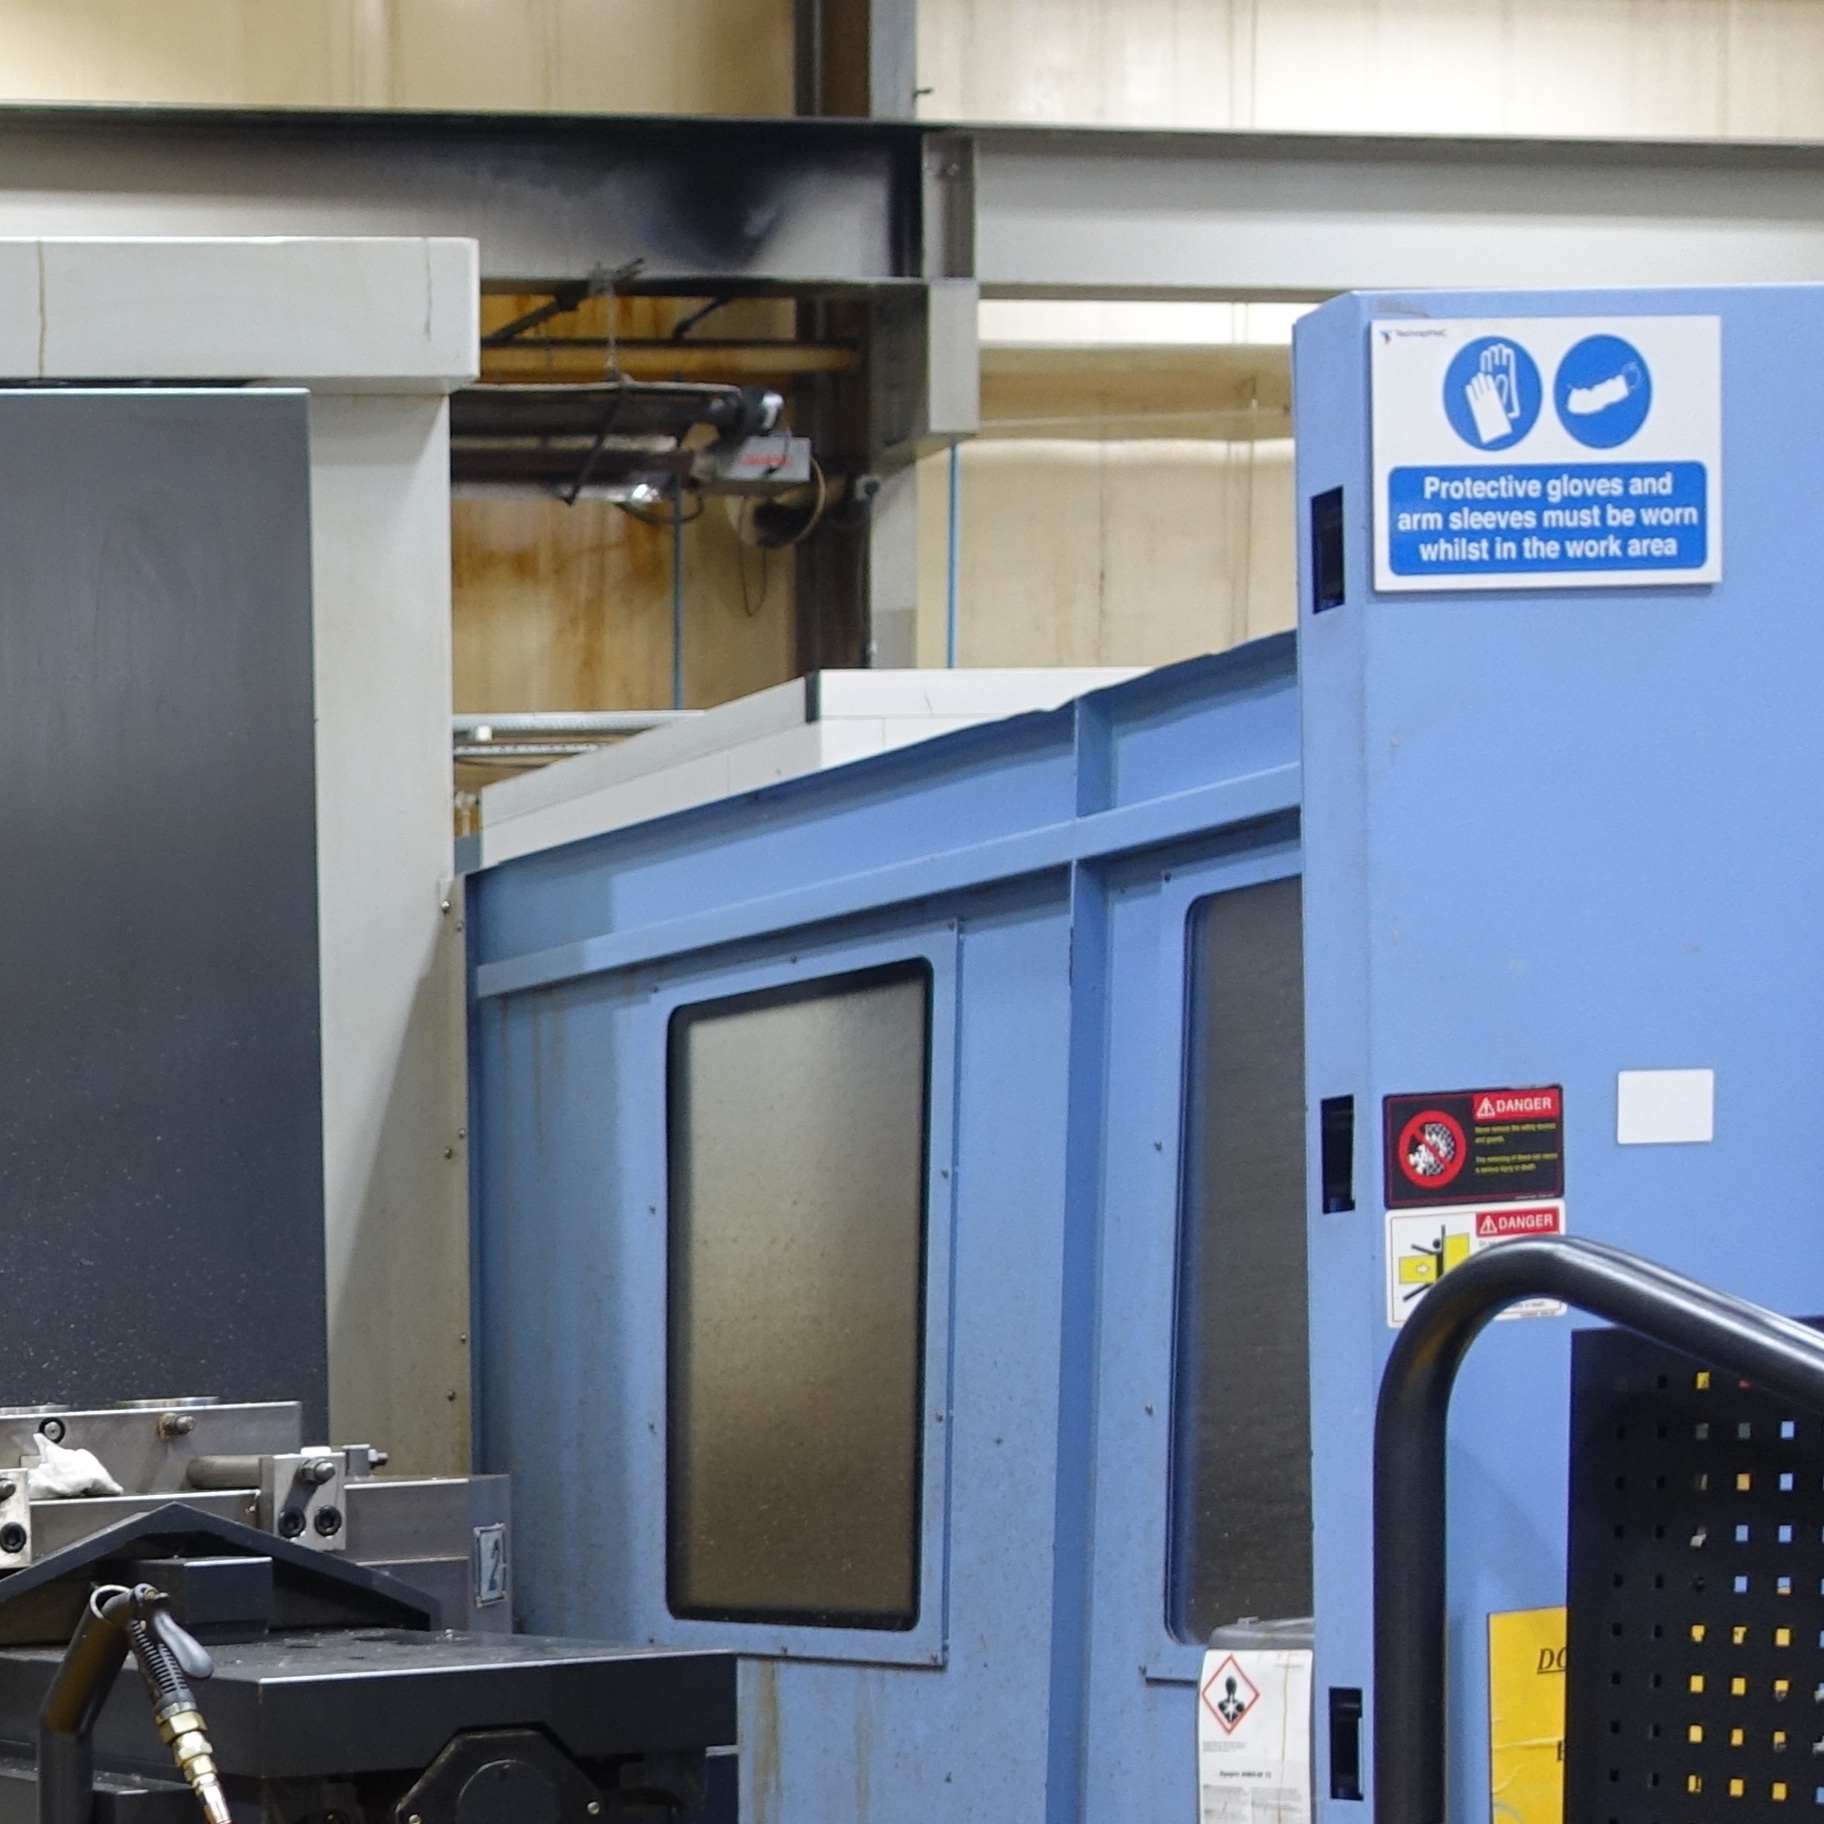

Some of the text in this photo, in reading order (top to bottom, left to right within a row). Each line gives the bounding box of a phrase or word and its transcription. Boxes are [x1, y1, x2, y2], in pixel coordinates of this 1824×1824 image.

[1423, 471, 1673, 503] Protective gloves and
[1397, 503, 1698, 531] arm sleeves must be worn
[1419, 534, 1678, 562] whilst in the work area
[1495, 1096, 1552, 1113] DANGER
[1498, 1213, 1554, 1230] DANGER
